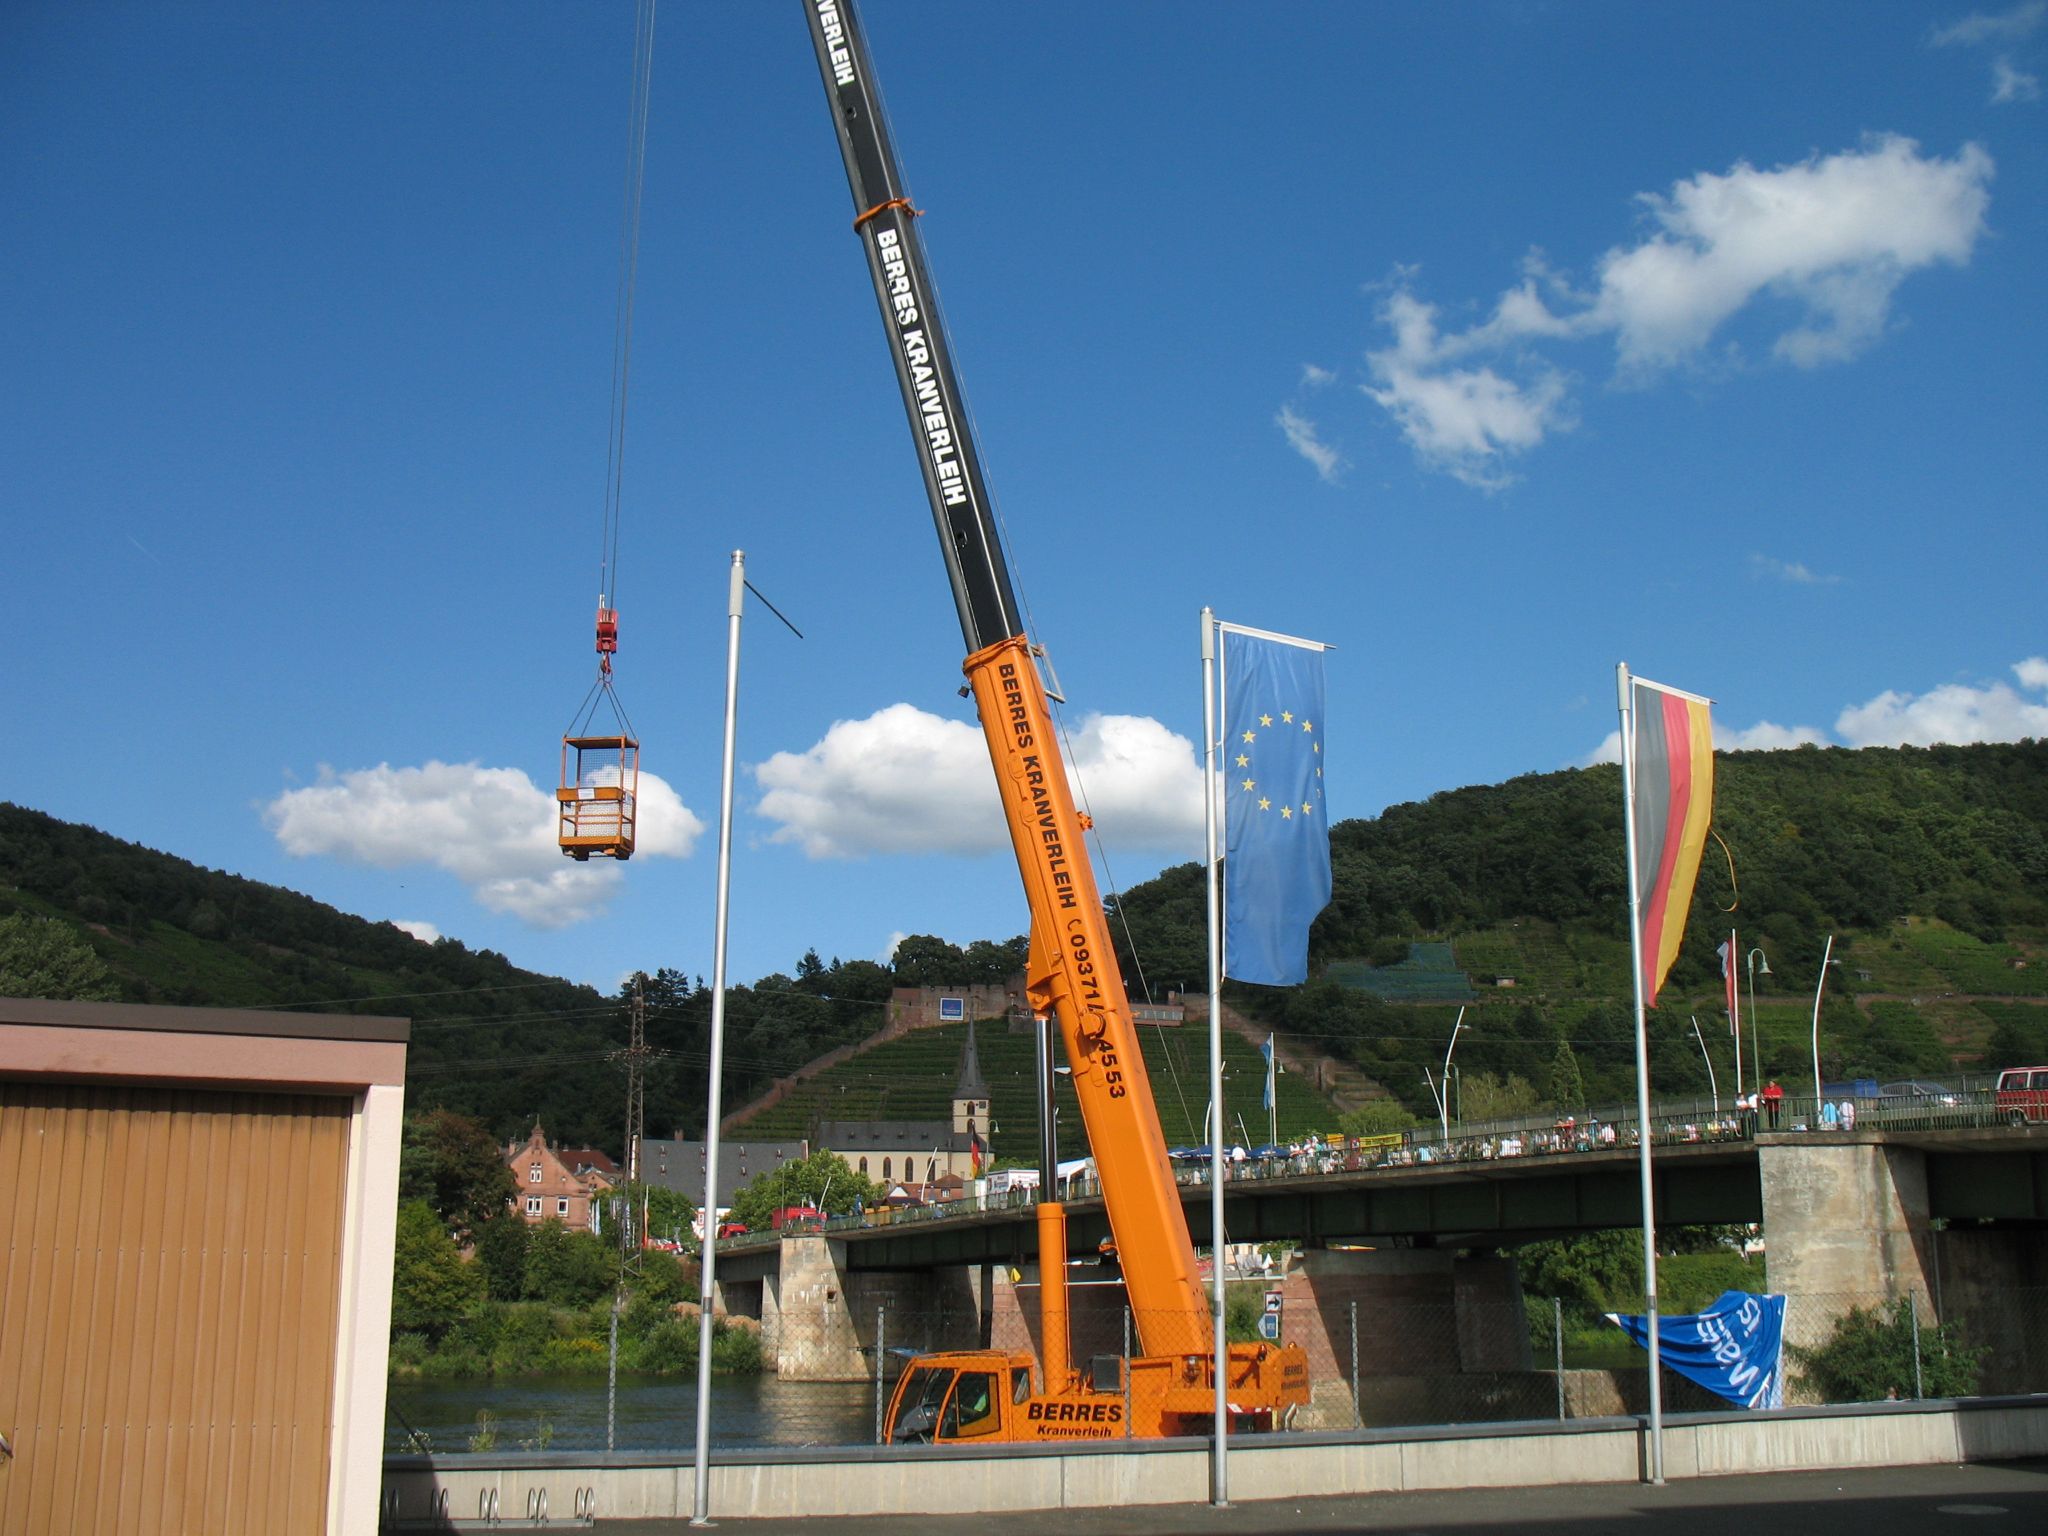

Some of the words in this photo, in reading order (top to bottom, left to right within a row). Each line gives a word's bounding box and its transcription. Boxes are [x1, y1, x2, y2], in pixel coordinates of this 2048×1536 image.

[816, 0, 855, 86] VERLEIH
[877, 228, 917, 325] BERRES
[904, 330, 966, 506] KRANVERLEIH
[999, 663, 1033, 749] BERRES
[1023, 756, 1076, 908] KRANVERLEIH
[1028, 1402, 1122, 1422] BERRES
[1037, 1425, 1112, 1438] Kranverleih
